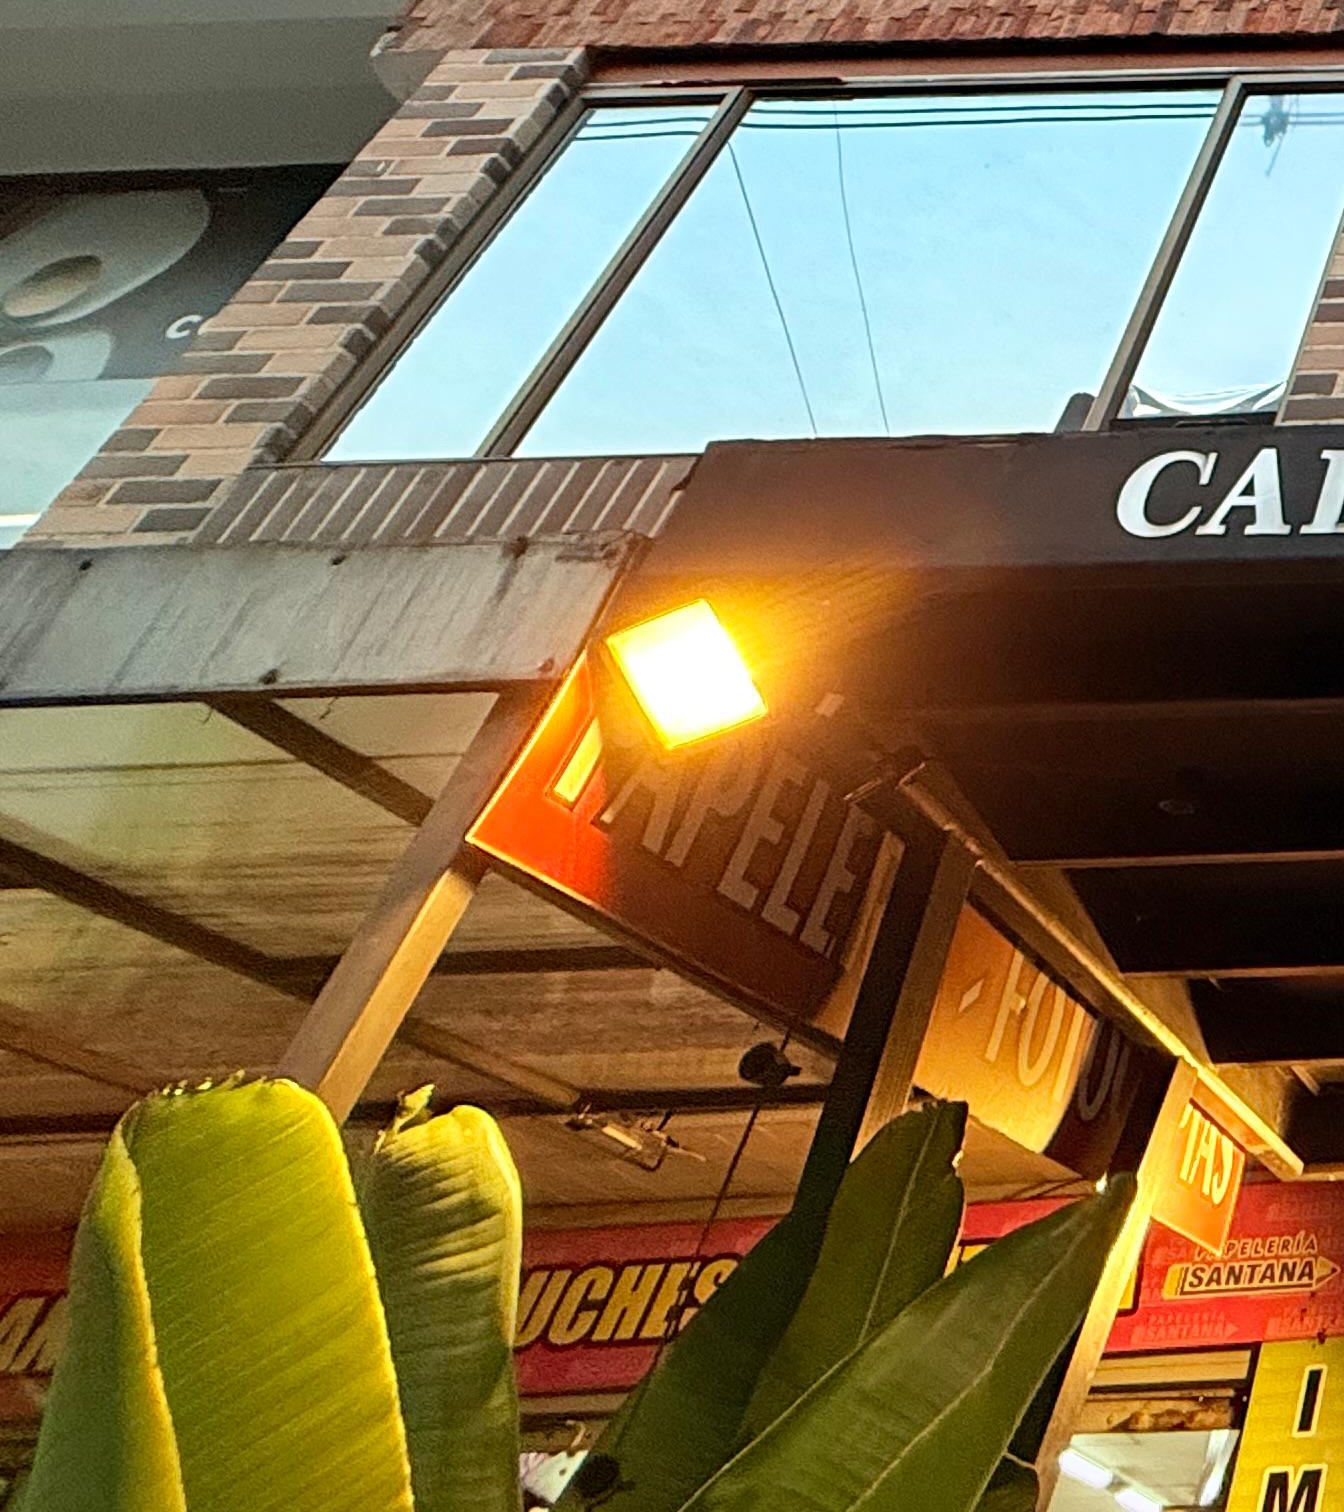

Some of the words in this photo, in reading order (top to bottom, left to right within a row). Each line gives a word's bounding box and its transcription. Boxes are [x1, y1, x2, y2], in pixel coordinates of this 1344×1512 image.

[553, 718, 882, 960] APELE
[1187, 1259, 1316, 1288] SANTANA
[1193, 1230, 1318, 1262] PELERÍA
[513, 1258, 740, 1346] UCHES
